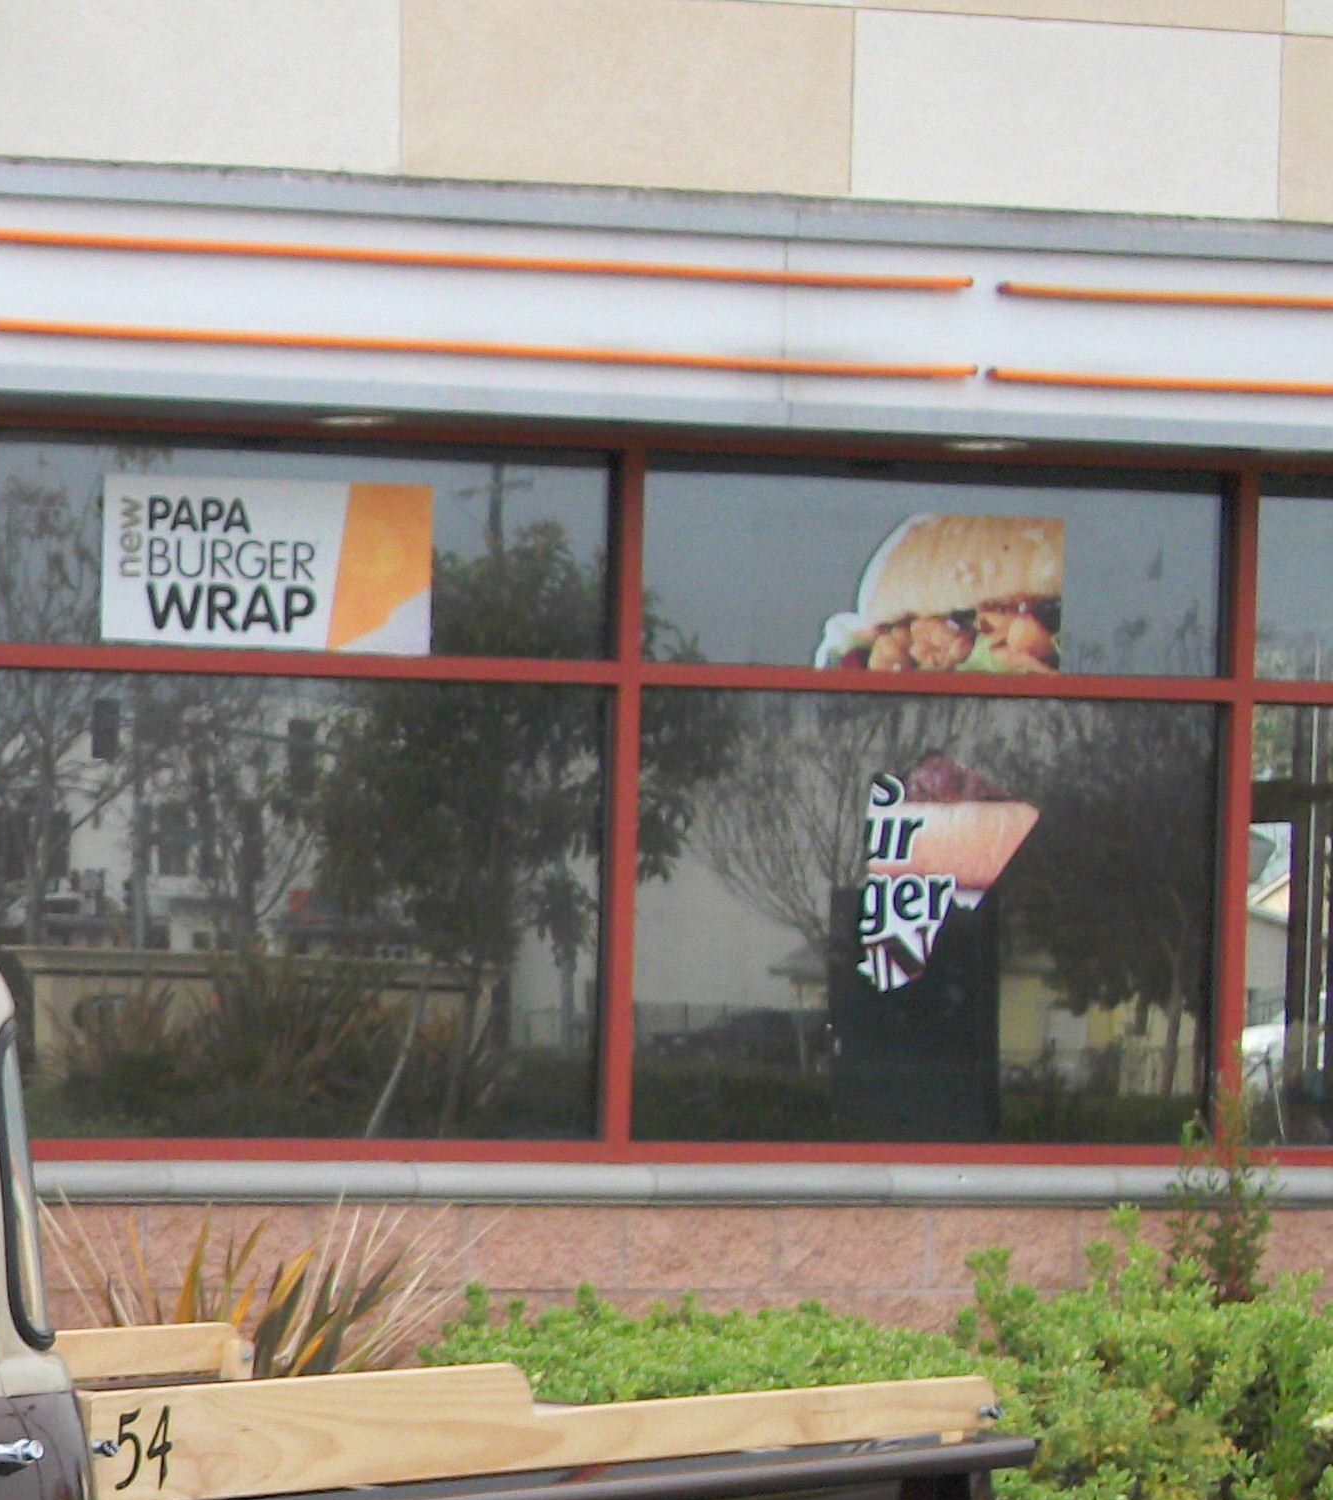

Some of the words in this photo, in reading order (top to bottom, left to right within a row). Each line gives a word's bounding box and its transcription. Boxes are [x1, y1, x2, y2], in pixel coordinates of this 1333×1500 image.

[118, 496, 142, 578] new
[147, 495, 251, 533] PAPA
[146, 536, 316, 582] BURGER
[146, 581, 318, 634] WRAP
[115, 1405, 172, 1491] 54
